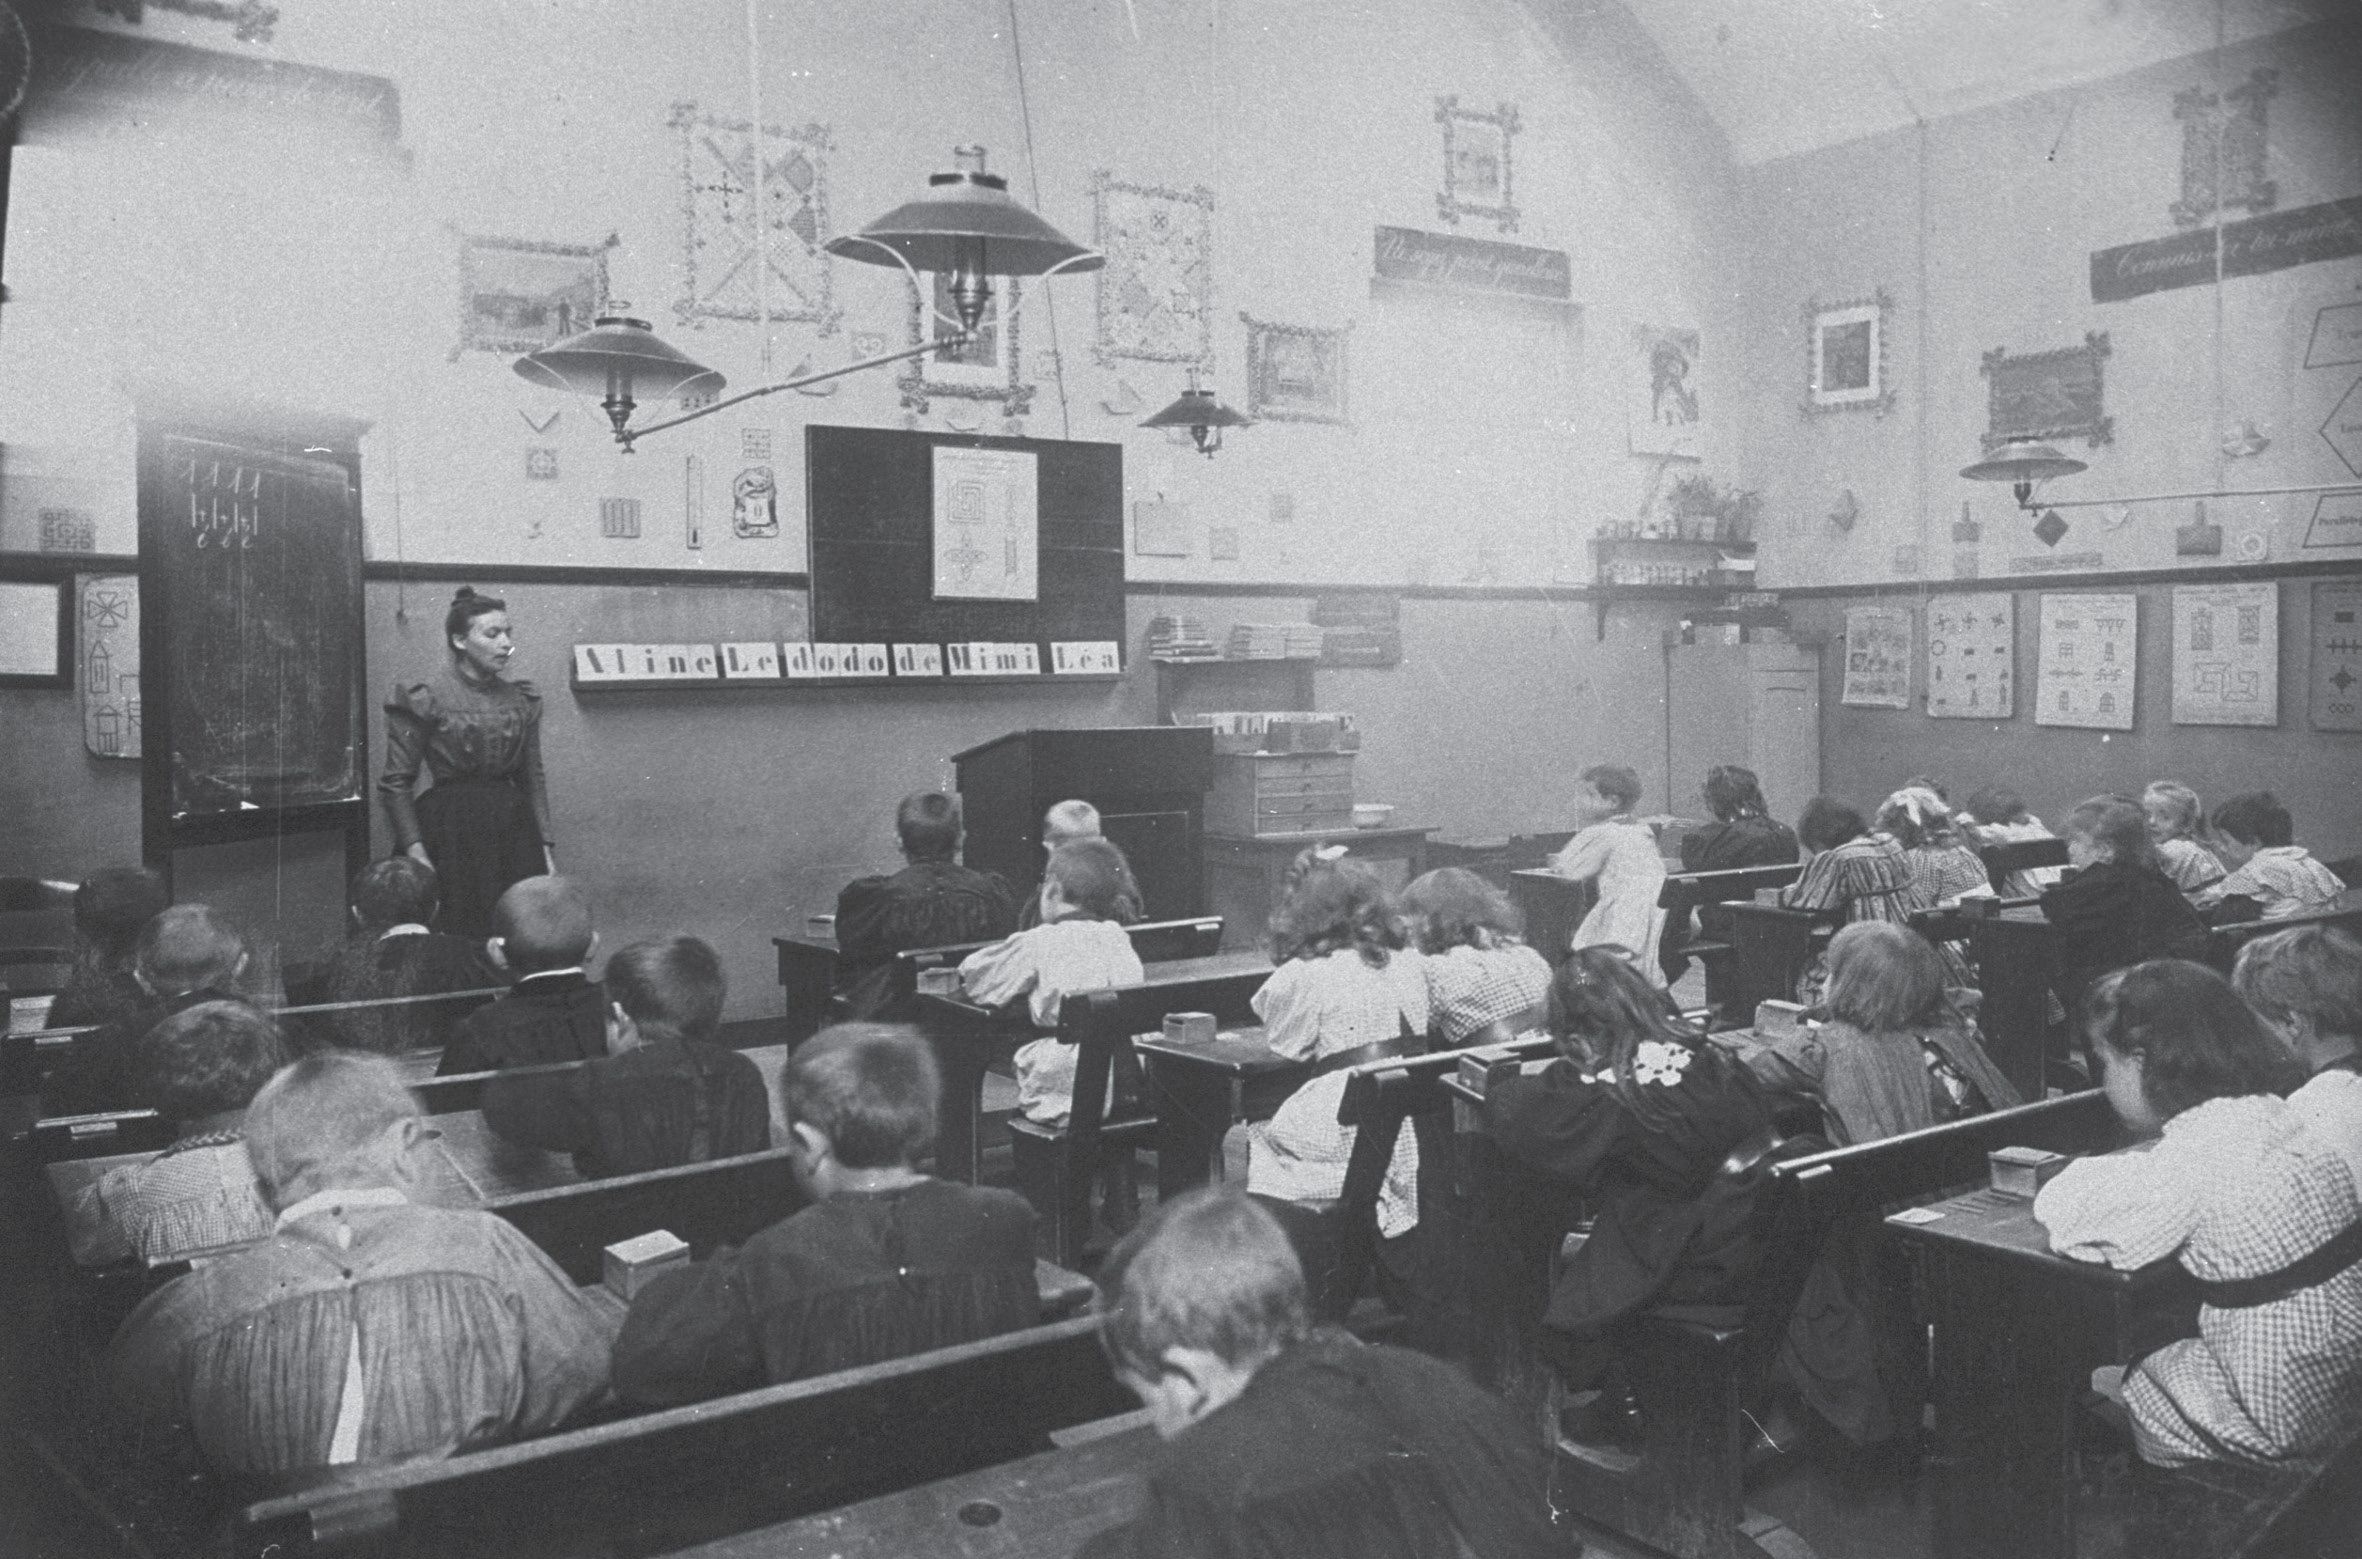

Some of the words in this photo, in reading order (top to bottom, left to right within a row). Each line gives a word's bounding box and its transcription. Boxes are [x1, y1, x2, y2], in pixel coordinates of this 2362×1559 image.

[585, 647, 713, 674] Aline
[727, 646, 773, 672] Le
[792, 645, 884, 672] dodo
[899, 646, 938, 671] de
[949, 645, 1034, 670] Mimi
